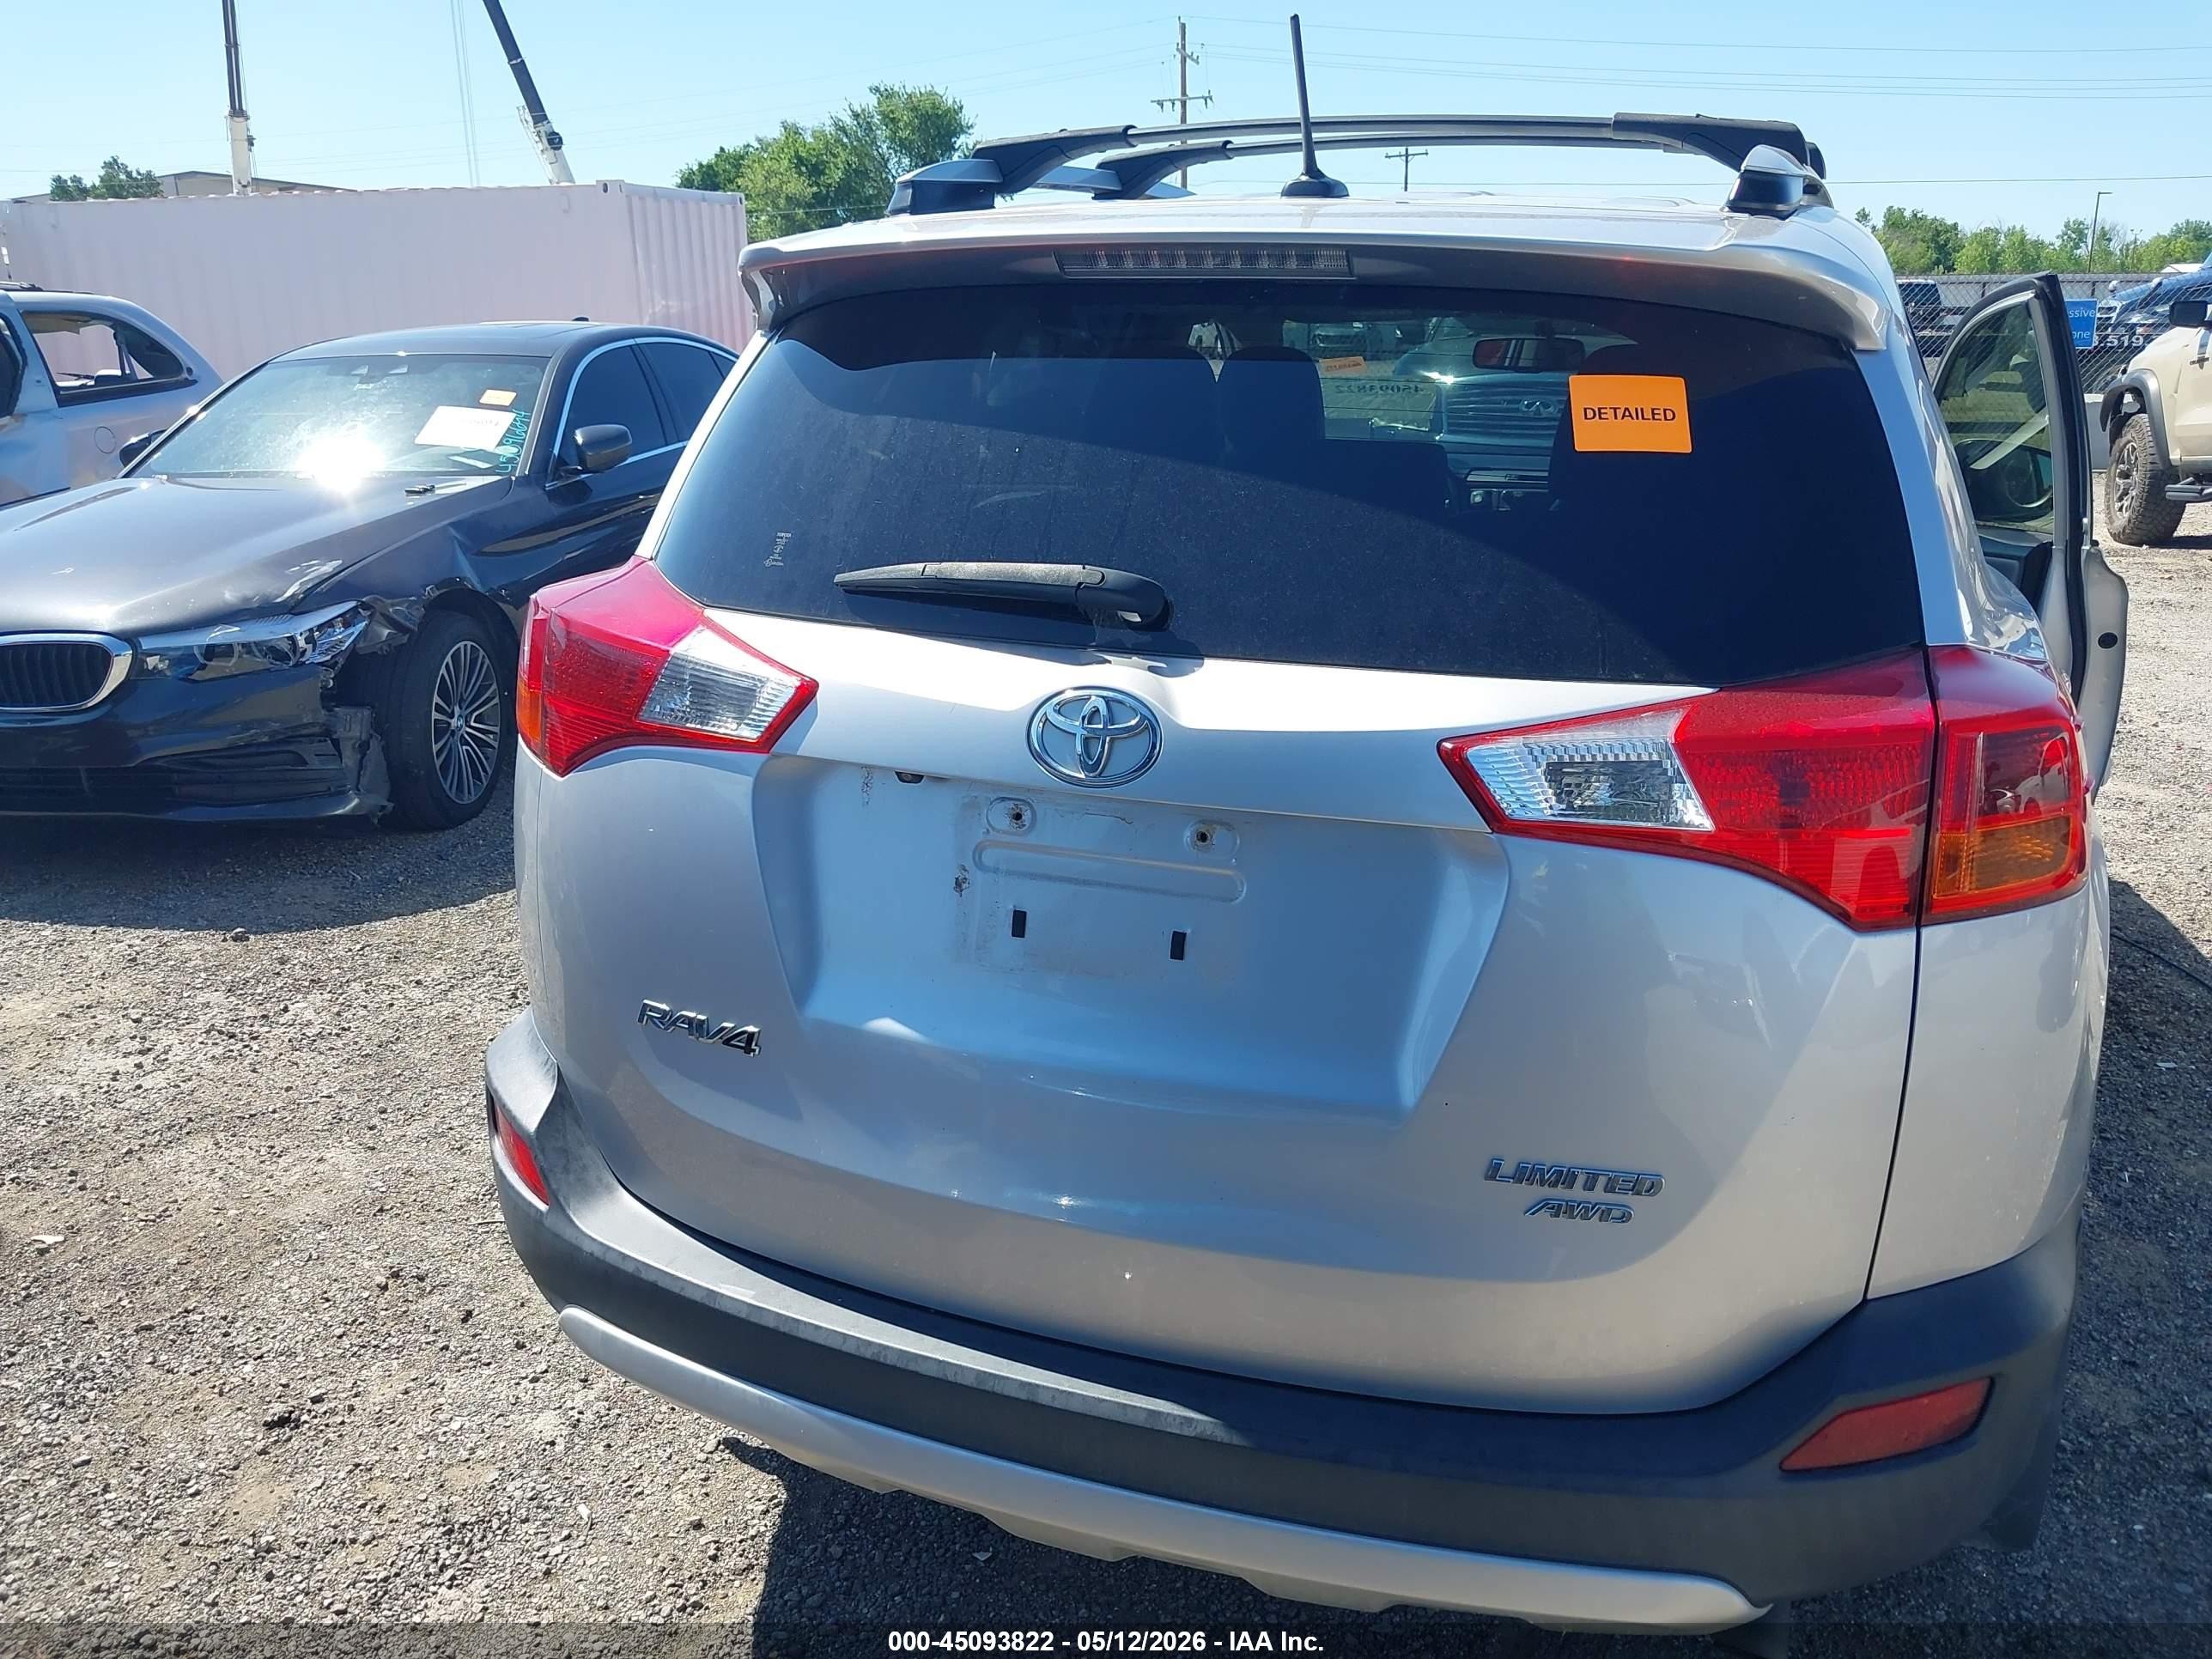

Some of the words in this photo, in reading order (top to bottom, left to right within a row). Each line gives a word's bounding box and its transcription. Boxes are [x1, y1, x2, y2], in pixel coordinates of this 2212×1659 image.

[2069, 307, 2096, 318] ssive
[1583, 406, 1677, 422] DETAILED
[637, 999, 763, 1057] RAV4
[1484, 1158, 1666, 1197] LIMITED
[1524, 1198, 1635, 1224] AWD
